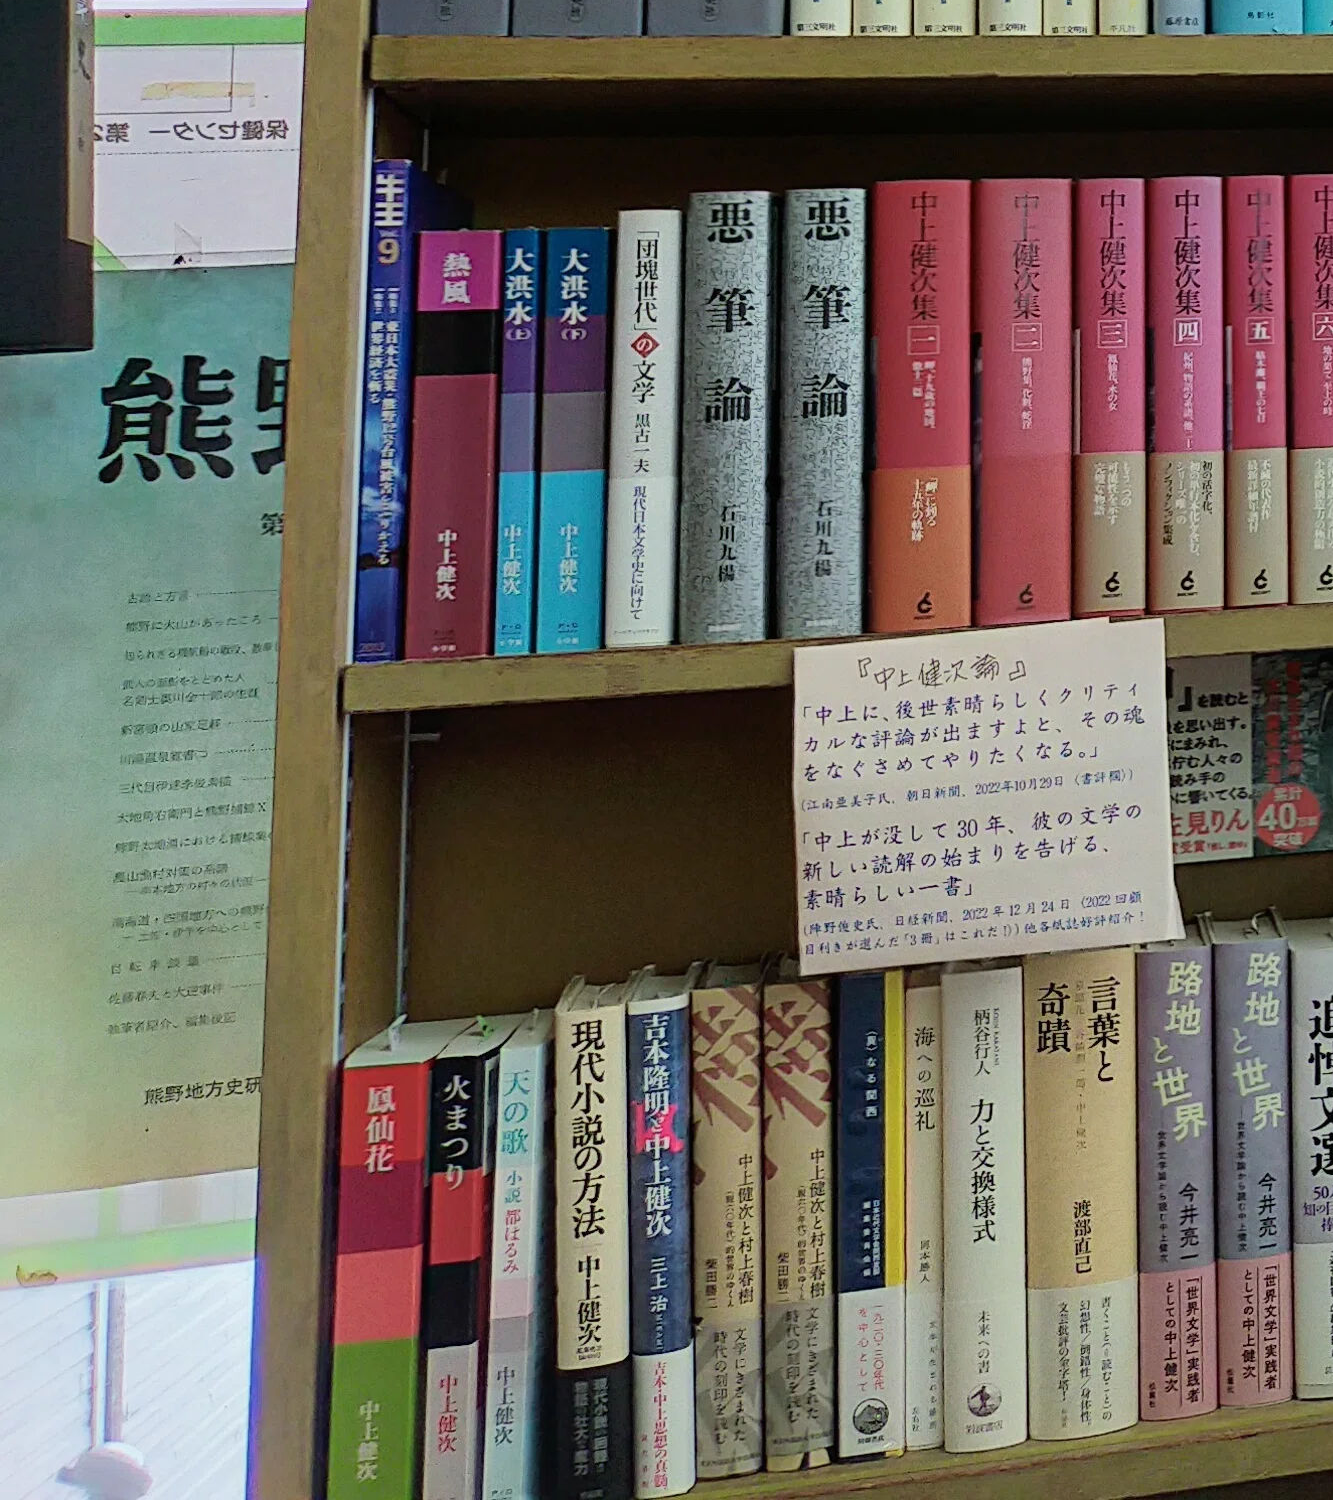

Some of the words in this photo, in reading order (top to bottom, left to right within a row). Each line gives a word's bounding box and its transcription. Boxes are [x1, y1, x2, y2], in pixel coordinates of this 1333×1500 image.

[441, 251, 472, 305] 熱風
[908, 190, 940, 322] 中上健次集
[1011, 191, 1041, 321] 中上健次集
[1098, 189, 1128, 318] 中上健次集
[1173, 188, 1202, 315] 中上健次集
[1246, 187, 1275, 314] 中上健次集
[703, 198, 756, 426] 悪筆論
[800, 196, 853, 422] 悪筆論
[435, 528, 459, 601] 中上健次
[502, 523, 522, 597] 中上健次
[558, 522, 581, 594] 中上健次
[973, 1007, 992, 1077] 柄谷行人
[1036, 982, 1071, 1054] 奇蹟
[1086, 977, 1122, 1084] 言葉と
[1151, 961, 1208, 1142] 路地と世界
[1231, 951, 1286, 1131] 路地と世界
[363, 1084, 396, 1174] 鳳仙花
[440, 1074, 472, 1190] 火まつり
[501, 1069, 531, 1155] 天の歌
[570, 1019, 607, 1240] 現代小説の方法
[643, 1013, 673, 1238] 吉本隆明と中上健次
[914, 1026, 936, 1132] 海への巡礼
[808, 1147, 827, 1300] 中上健次と村上春樹
[969, 1098, 997, 1244] 力と交換様式
[1178, 1182, 1200, 1262] 今井亮一
[1258, 1171, 1278, 1251] 今井亮一
[736, 1153, 755, 1304] 中上健次と村上春樹
[577, 1253, 602, 1345] 中上健次
[976, 1309, 991, 1376] 未来への書
[356, 1399, 381, 1482] 中上健次
[435, 1373, 459, 1454] 中上健次
[493, 1364, 516, 1447] 中上健次
